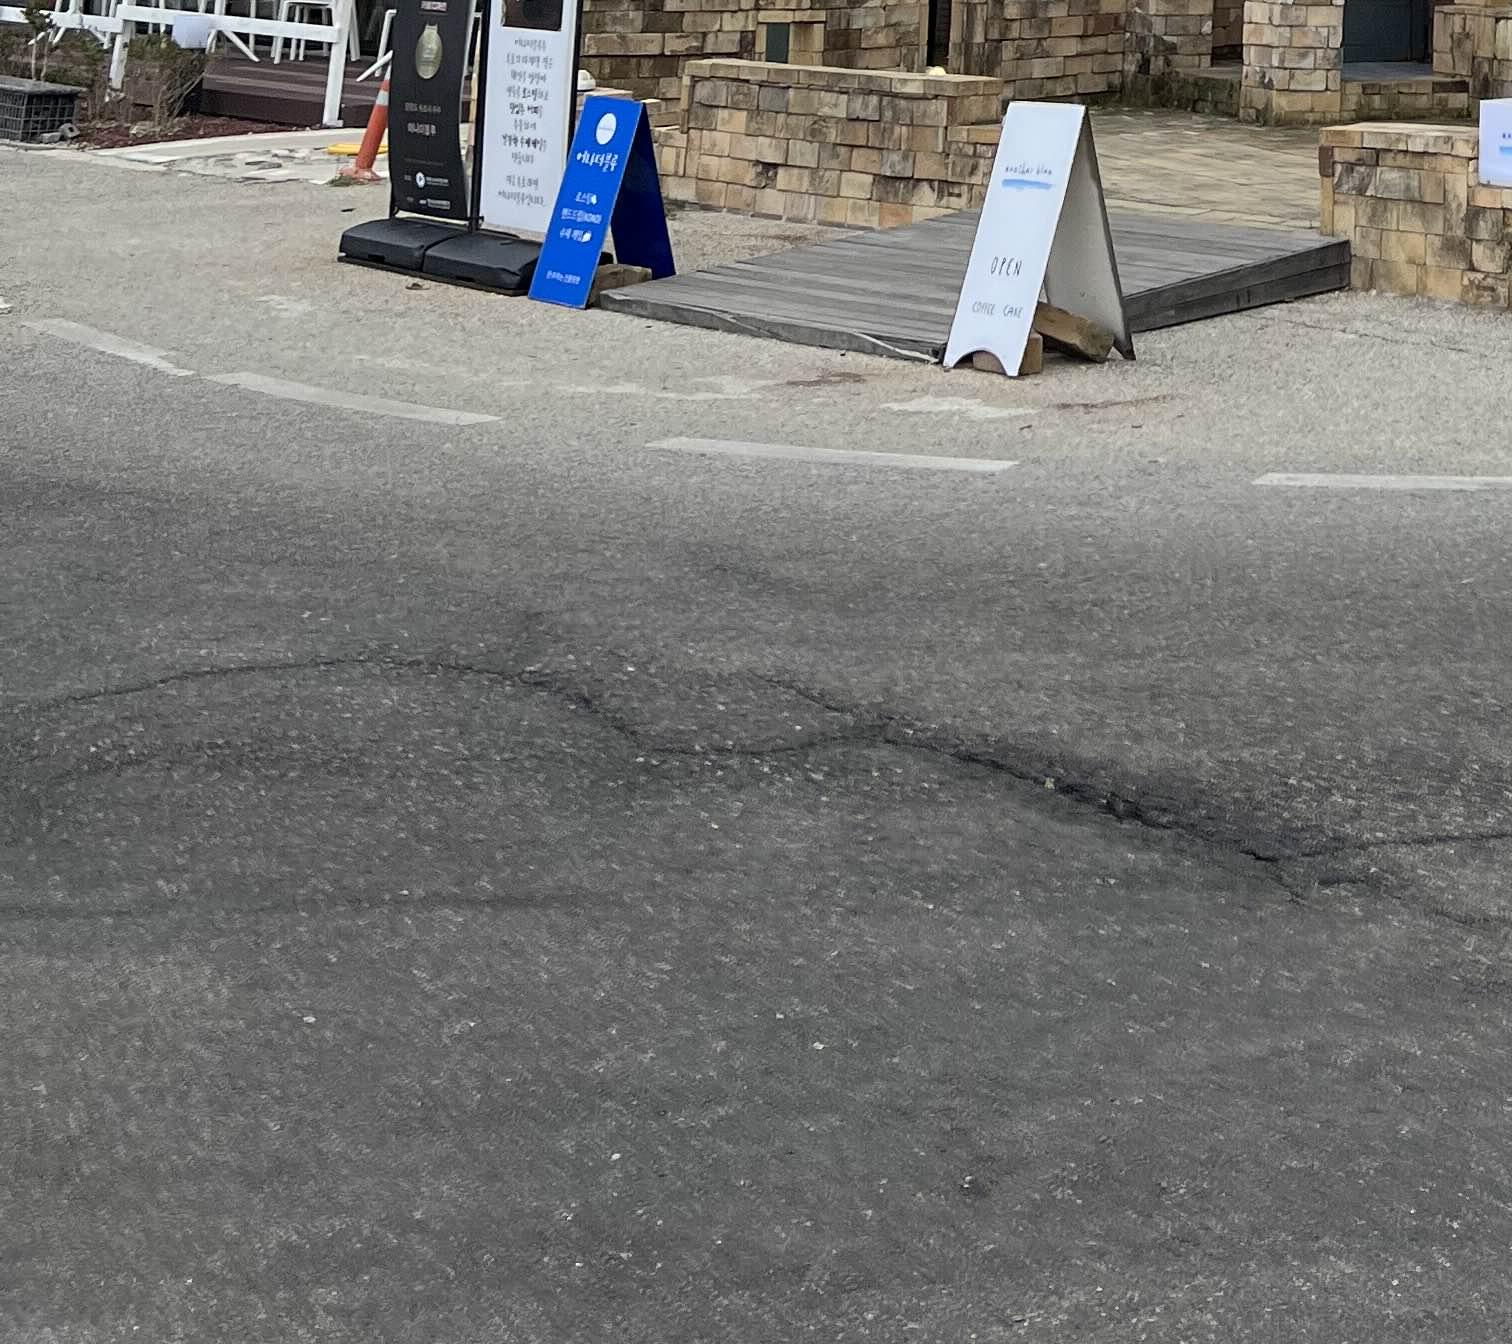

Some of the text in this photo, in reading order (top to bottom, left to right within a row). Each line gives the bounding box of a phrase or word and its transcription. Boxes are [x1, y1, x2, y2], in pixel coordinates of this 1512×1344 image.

[576, 150, 619, 172] 어나더블루
[991, 256, 1023, 277] OPEN
[972, 301, 996, 316] COFFEE
